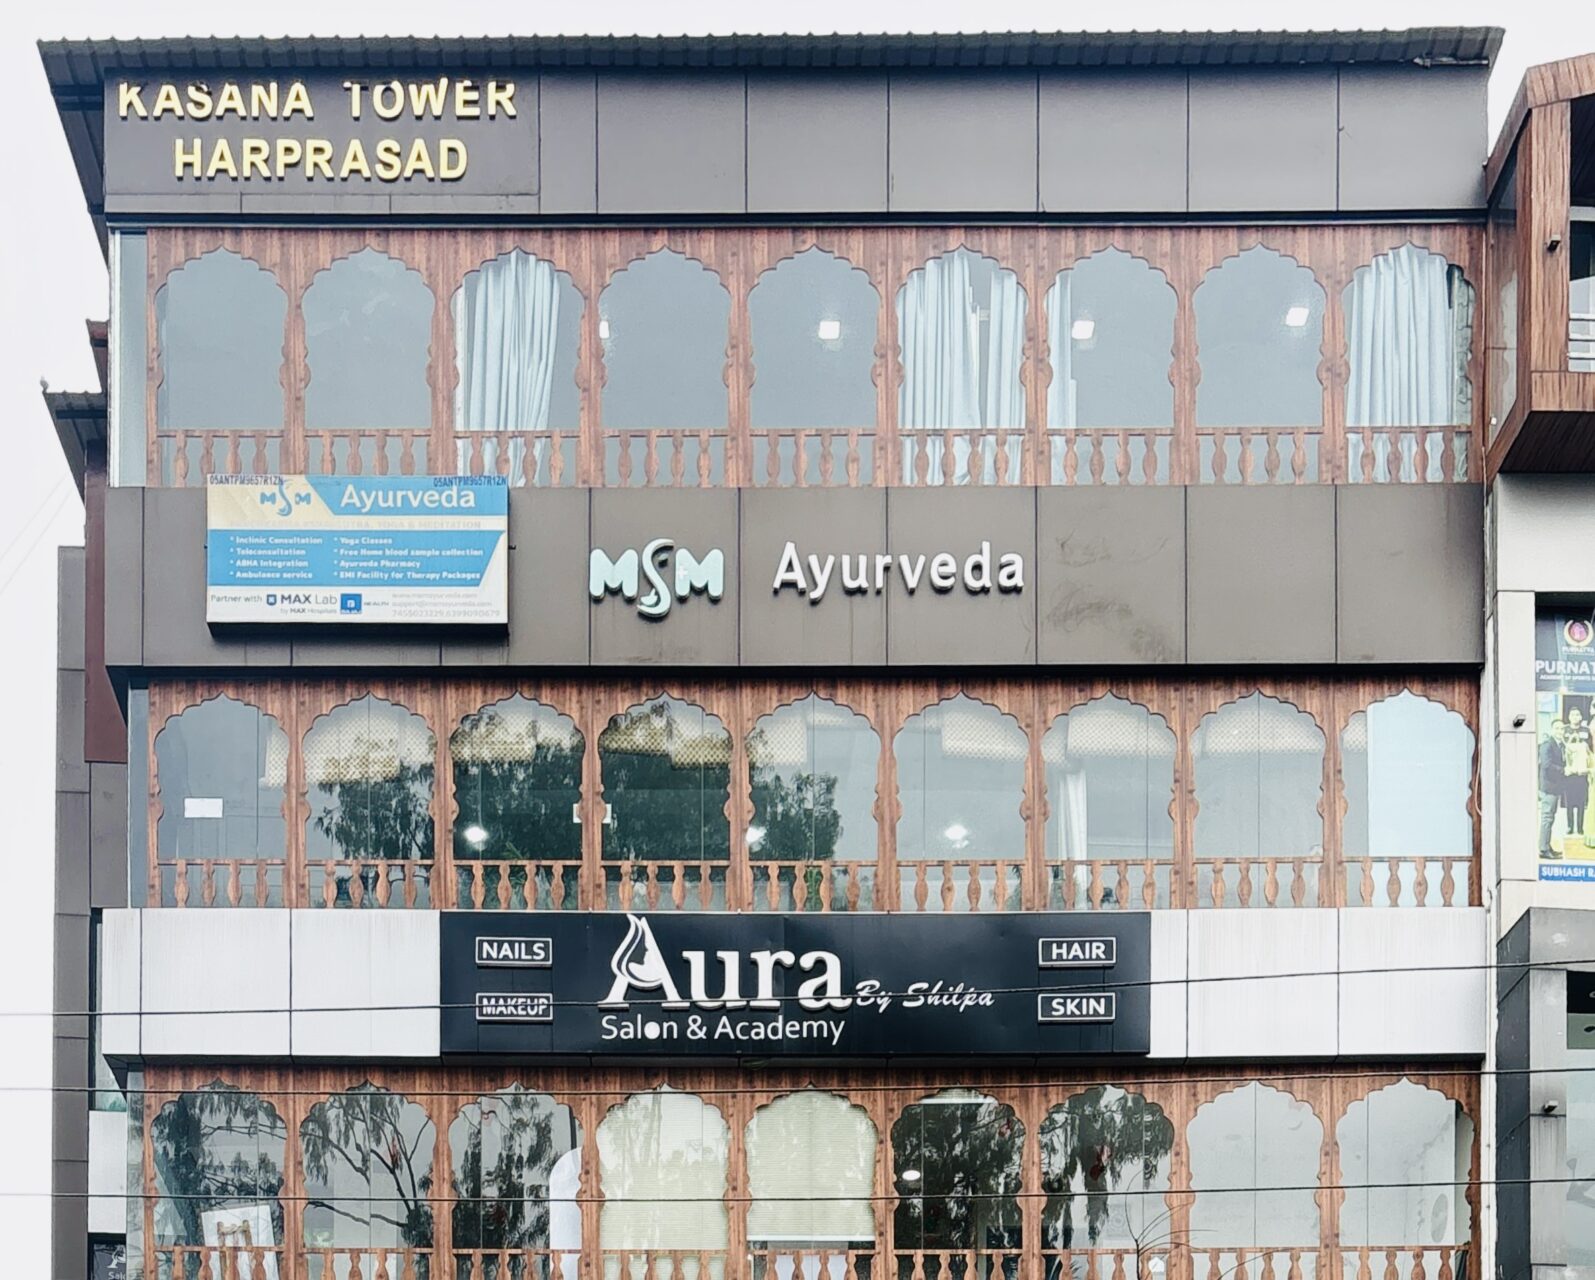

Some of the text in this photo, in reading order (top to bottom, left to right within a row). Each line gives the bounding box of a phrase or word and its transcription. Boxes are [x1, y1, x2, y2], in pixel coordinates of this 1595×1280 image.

[117, 76, 517, 120] KASANA TOWER
[174, 137, 468, 181] HARPRASAD
[340, 484, 476, 513] Ayurveda
[269, 535, 323, 545] Consultation
[340, 537, 359, 545] Yoga
[260, 559, 309, 569] Integration
[772, 541, 1026, 602] Ayurveda
[391, 571, 404, 579] for
[589, 538, 725, 618] MSM
[211, 594, 263, 603] Partner with
[280, 594, 338, 605] MAX Lab
[1541, 866, 1586, 877] SUBHASH
[482, 941, 546, 960] NAILS
[1051, 941, 1106, 960] HAIR
[597, 912, 852, 1011] Aura
[856, 979, 996, 1014] By Shilpa
[482, 997, 549, 1016] MAKEUP
[1051, 997, 1106, 1016] SKIN
[600, 1014, 846, 1046] Salon & Academy
